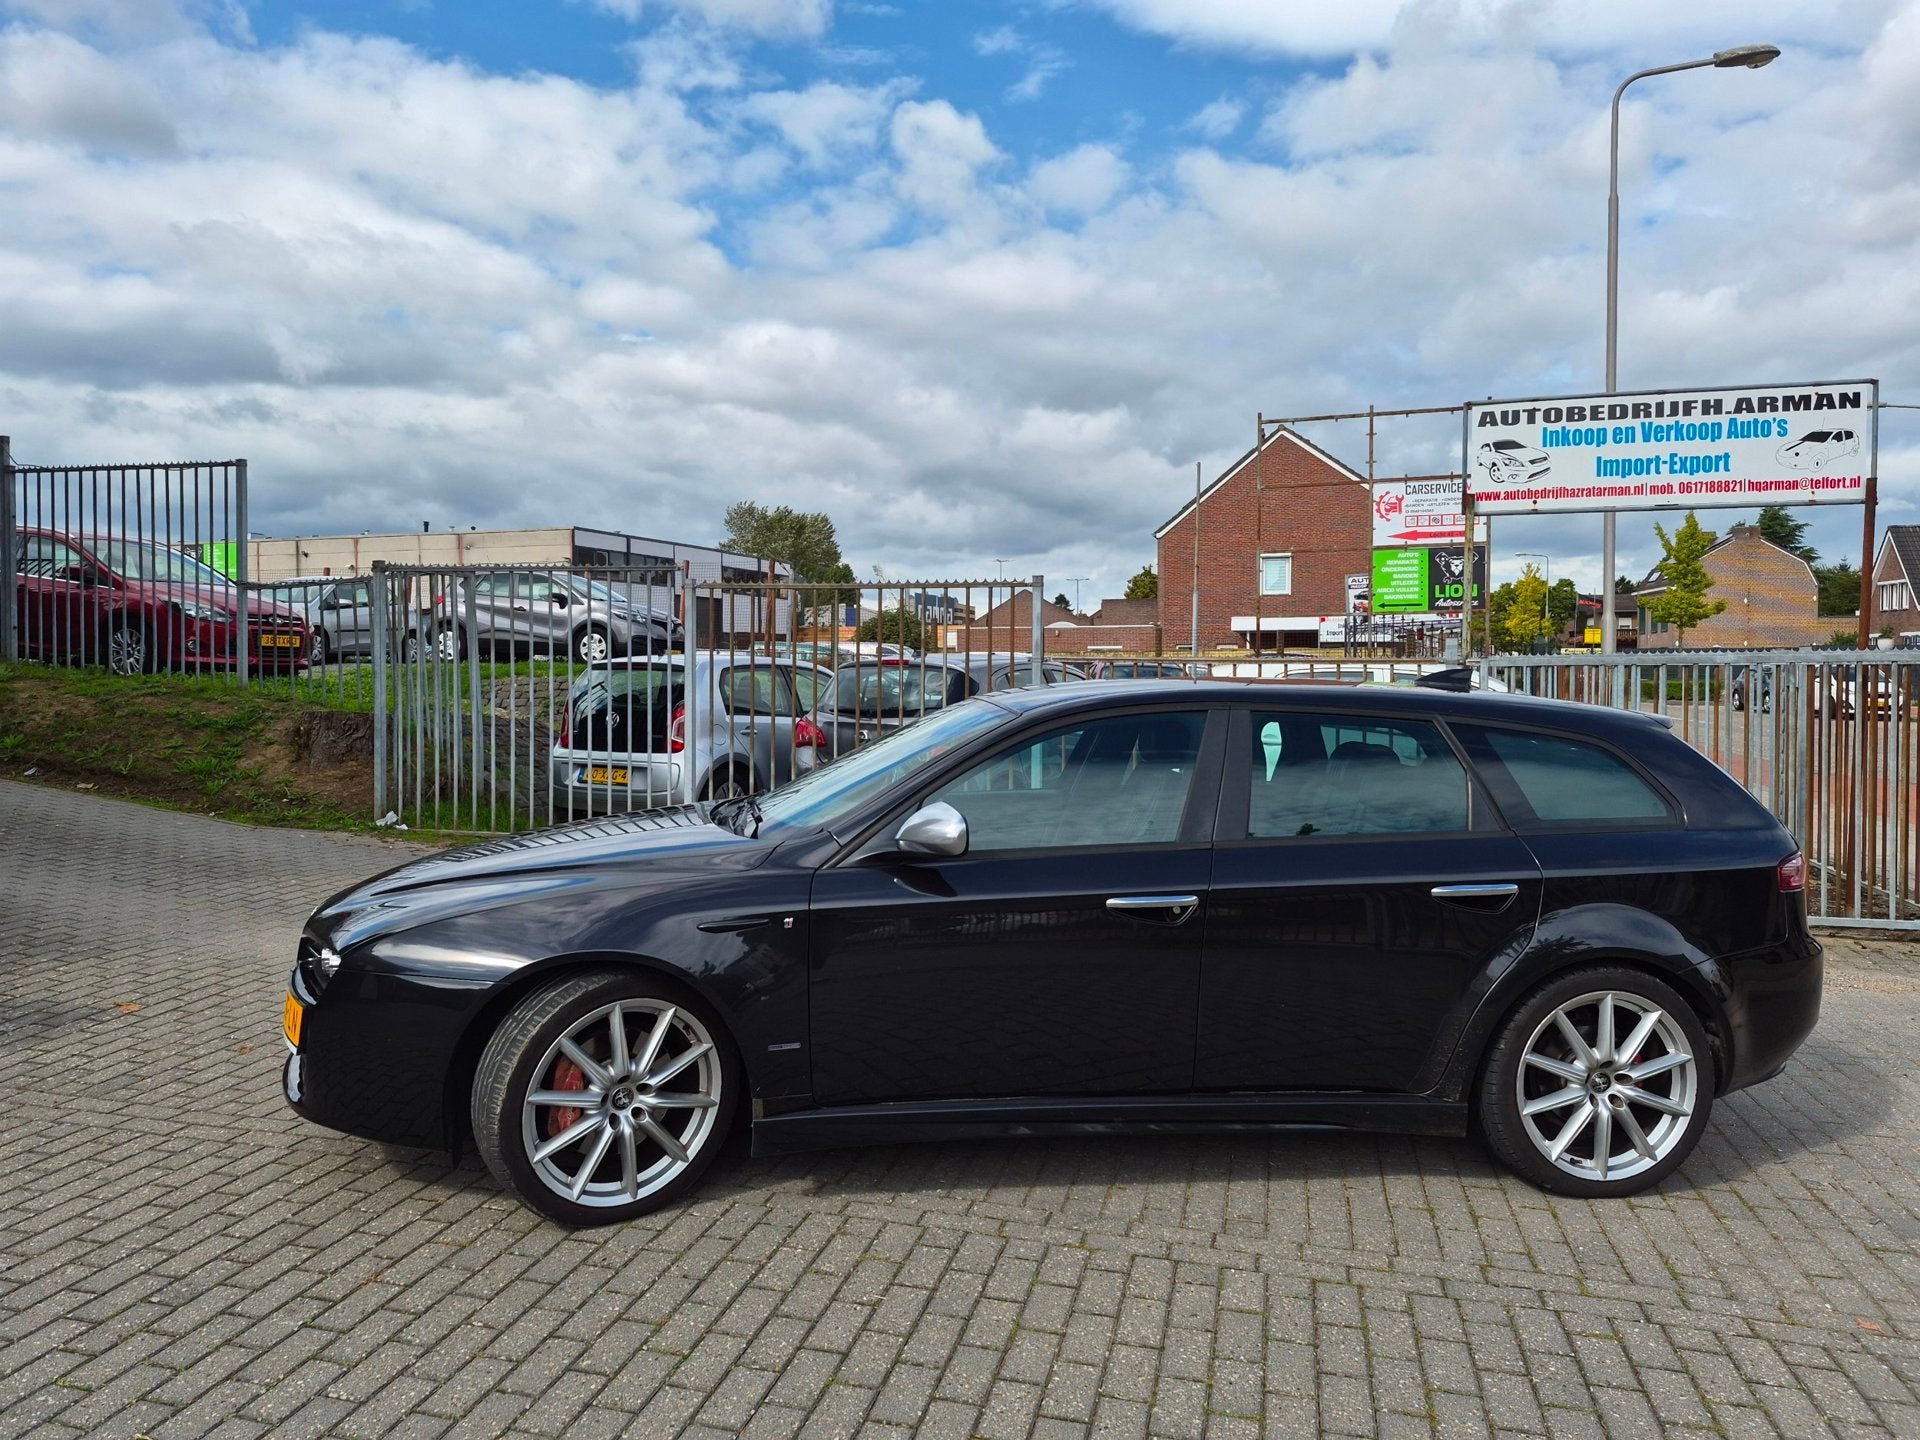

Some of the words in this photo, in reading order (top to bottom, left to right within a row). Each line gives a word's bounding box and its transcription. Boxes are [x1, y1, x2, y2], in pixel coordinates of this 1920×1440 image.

[1541, 425, 1608, 448] Inkoop
[1611, 425, 1636, 445] en
[1640, 419, 1723, 444] Verkoop
[1726, 416, 1789, 439] Auto's
[1595, 451, 1731, 479] Import-Export
[1405, 482, 1463, 496] CARSERVICE
[1649, 481, 1677, 496] mob.
[1678, 480, 1744, 495] 0617188821
